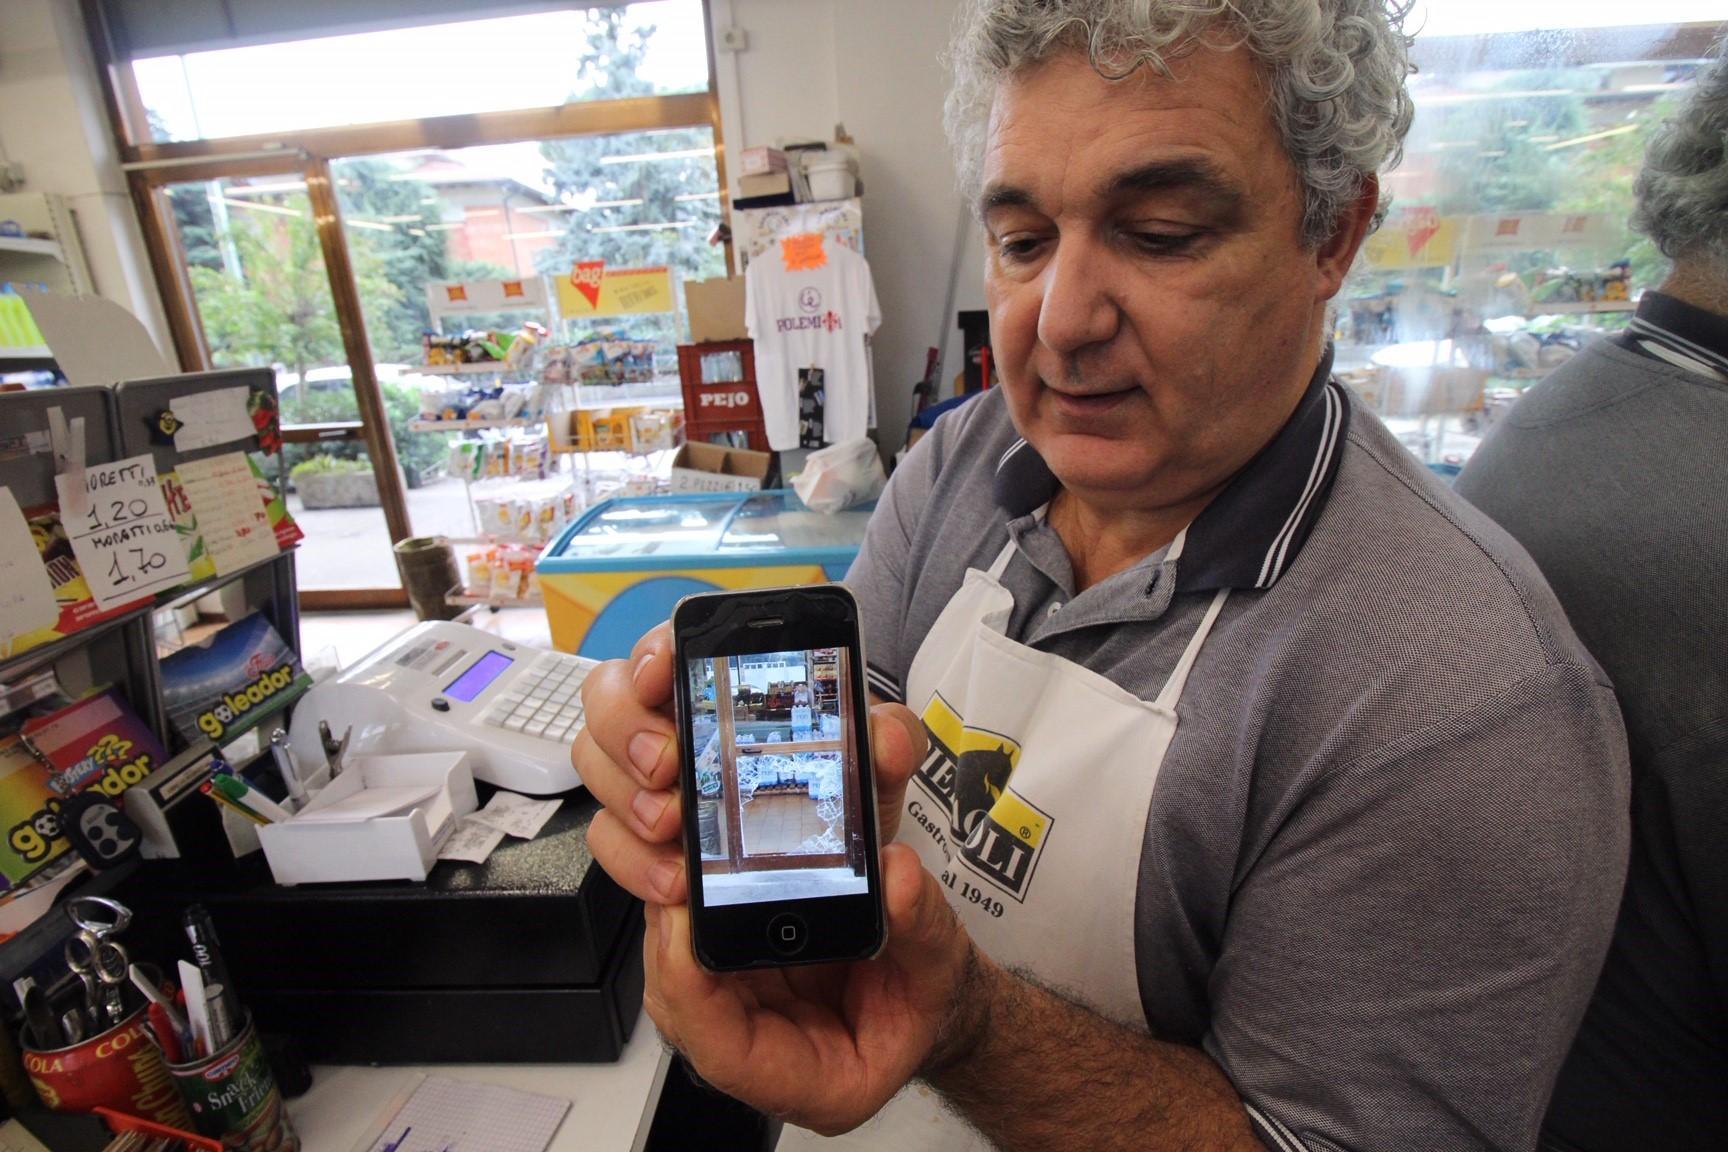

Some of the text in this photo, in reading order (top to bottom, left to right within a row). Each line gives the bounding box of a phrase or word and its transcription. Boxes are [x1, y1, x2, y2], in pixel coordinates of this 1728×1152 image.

[699, 391, 749, 408] PEJO
[86, 464, 145, 493] ORETTI
[87, 499, 148, 530] 1,20
[108, 548, 167, 586] 1,70
[198, 664, 294, 740] goleador
[961, 883, 1004, 918] 1949
